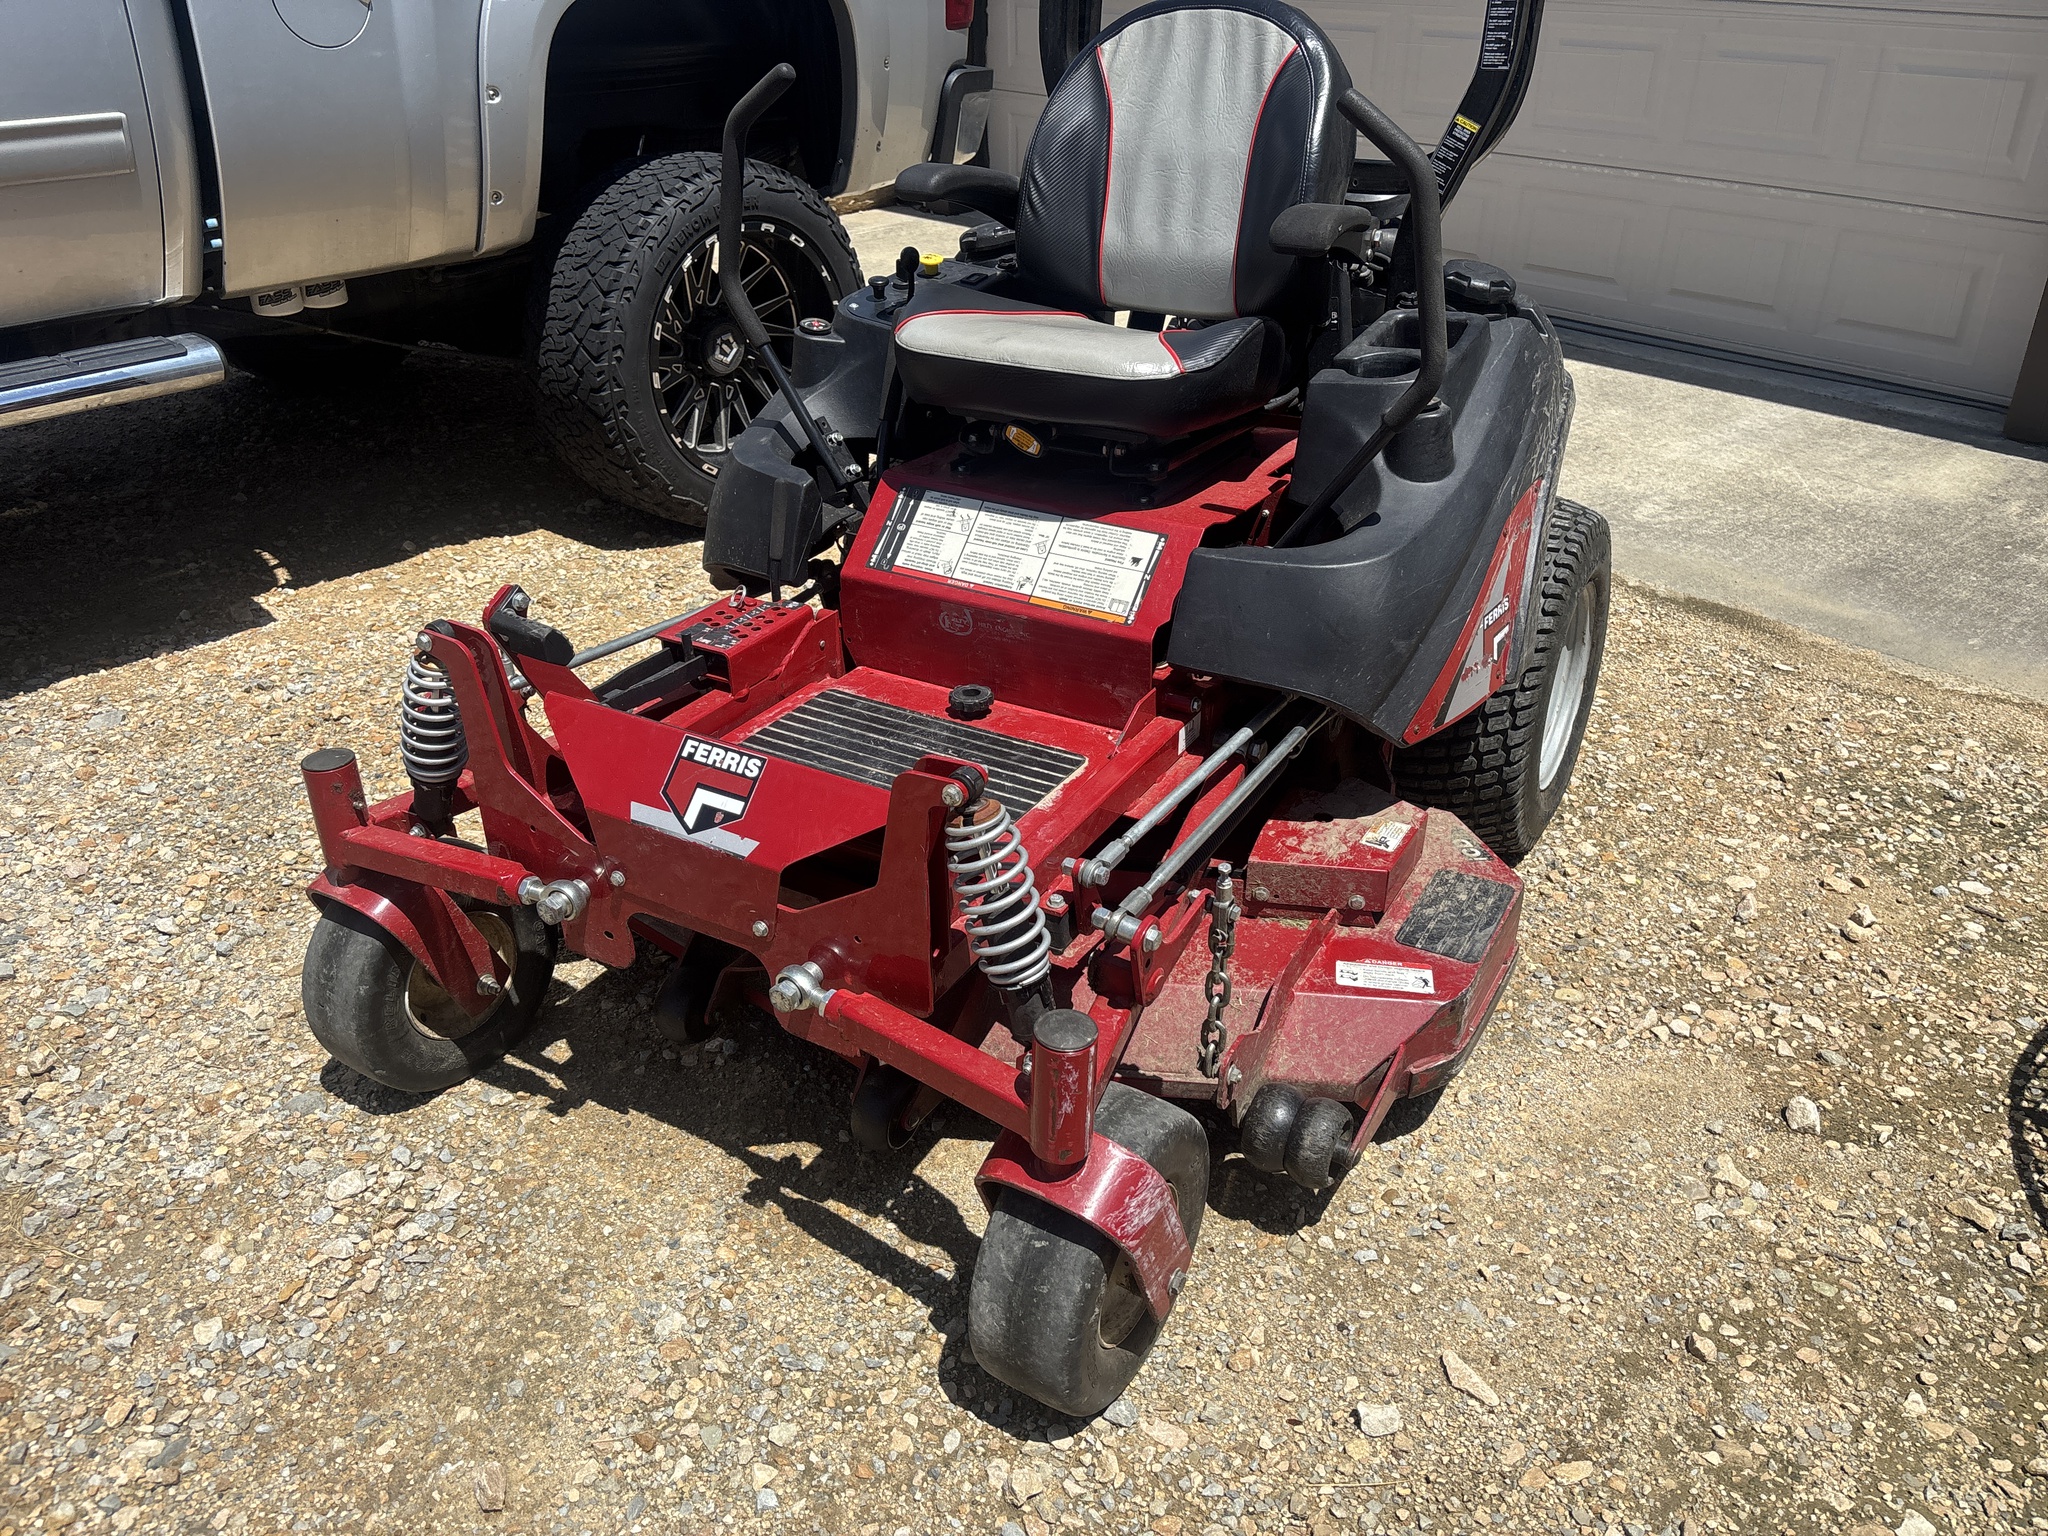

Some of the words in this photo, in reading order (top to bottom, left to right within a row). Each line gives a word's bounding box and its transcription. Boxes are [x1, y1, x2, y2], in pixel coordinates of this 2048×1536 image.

[1460, 119, 1477, 131] CAUTION
[258, 288, 292, 306] FASS
[946, 578, 969, 587] DANGER
[1061, 604, 1088, 613] WARNING
[1484, 598, 1510, 628] FERRIS
[682, 739, 762, 778] FERRIS
